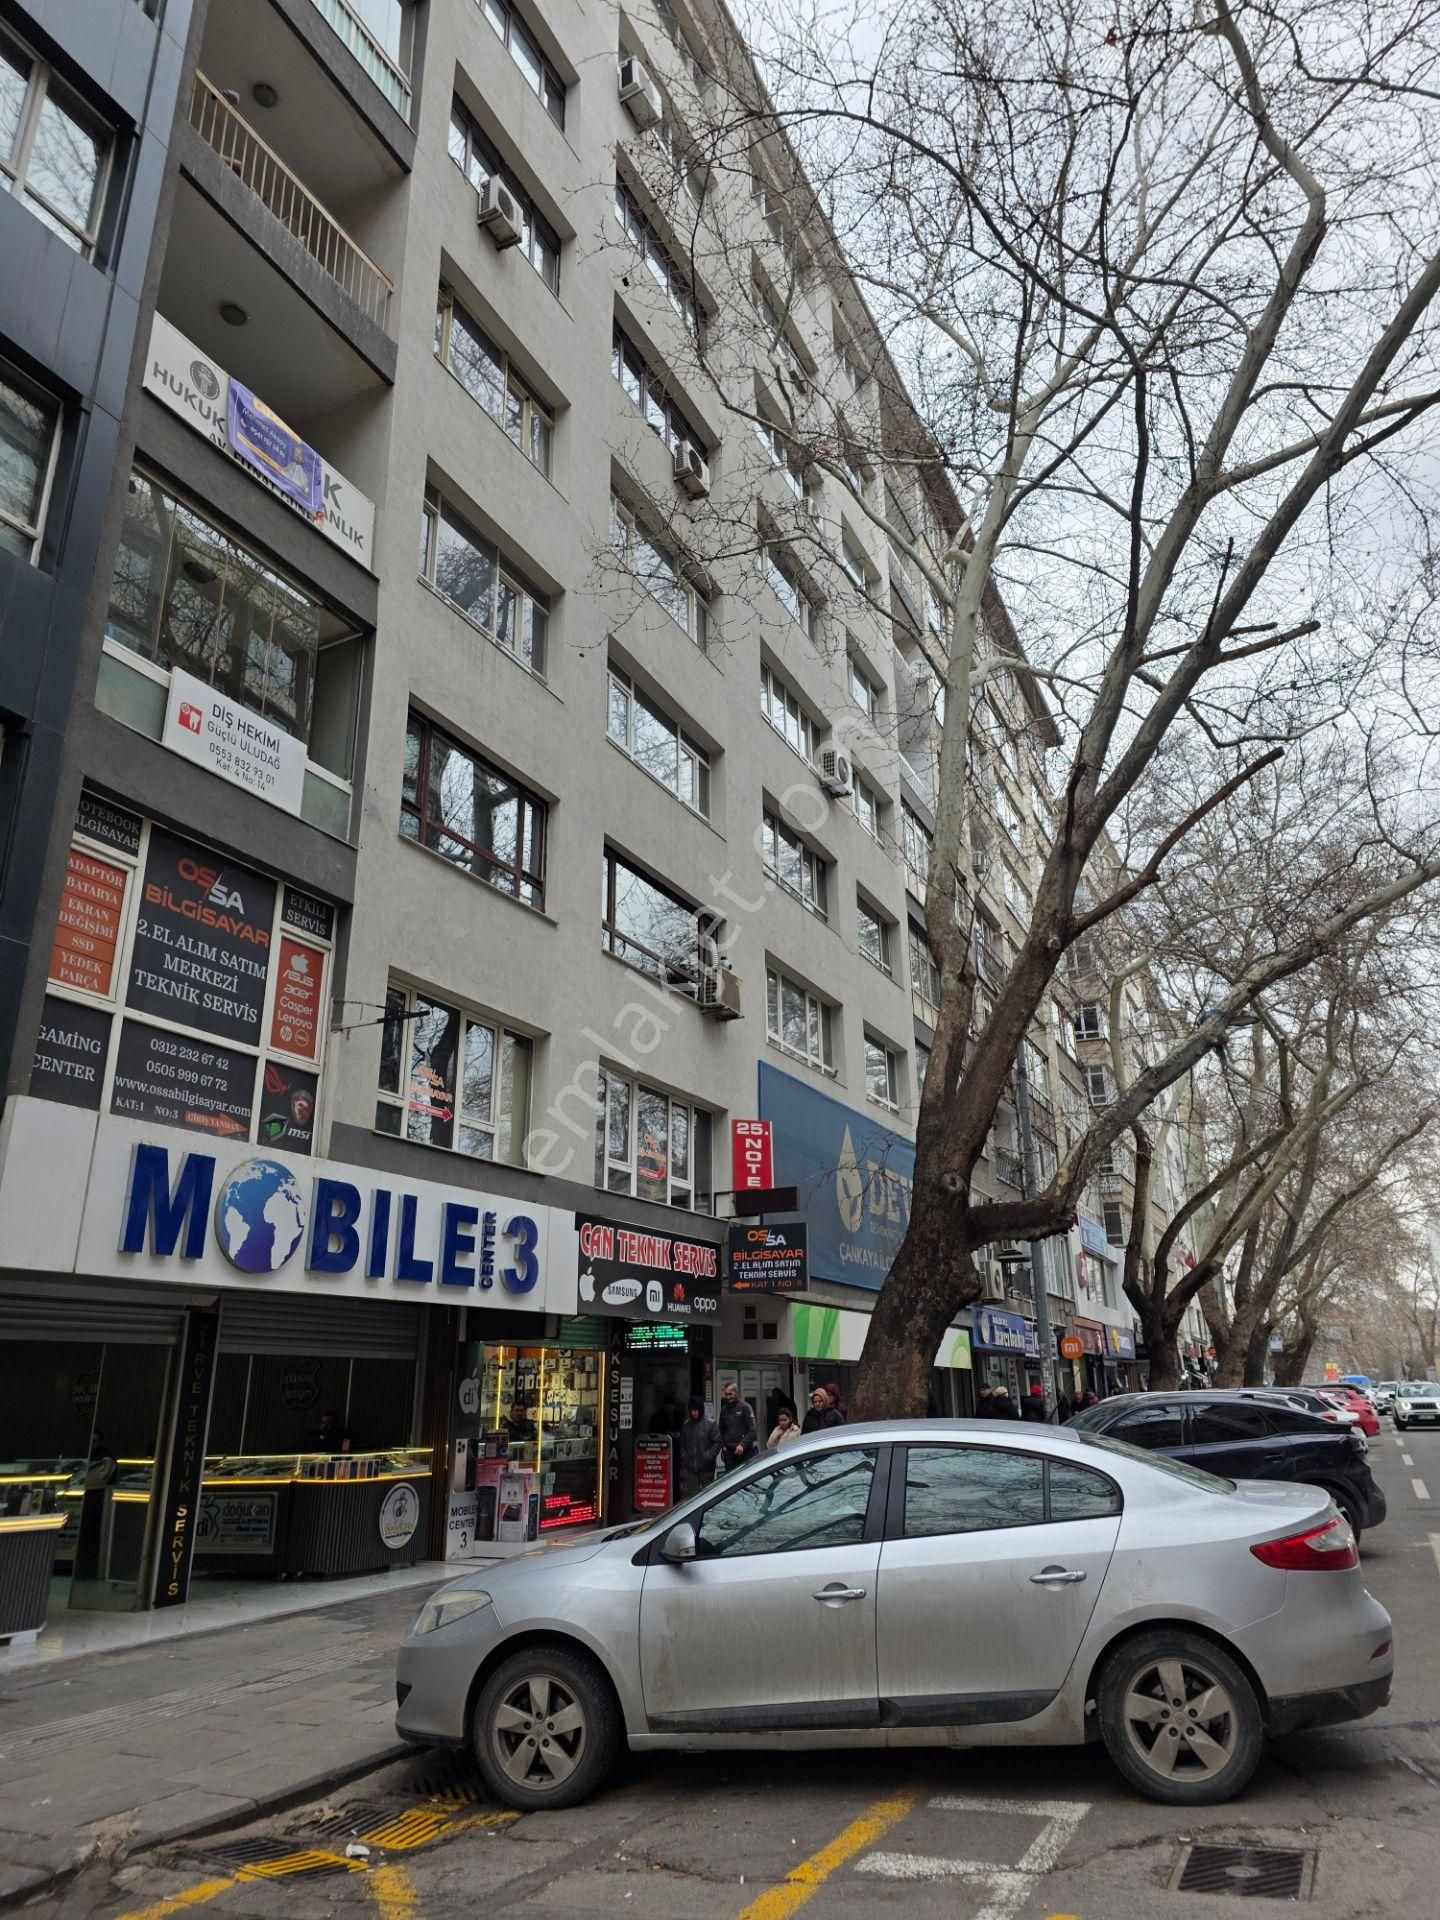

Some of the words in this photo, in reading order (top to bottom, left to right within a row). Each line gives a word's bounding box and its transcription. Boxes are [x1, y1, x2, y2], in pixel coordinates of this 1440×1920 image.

[153, 361, 227, 434] HUKUK
[212, 703, 234, 729] DİŞ
[237, 718, 281, 754] HEKİMİ
[207, 720, 237, 746] Güçlü
[240, 738, 281, 770] ULUDAĞ
[209, 742, 232, 762] 0553
[234, 756, 251, 773] 832
[253, 767, 263, 780] 93
[265, 774, 275, 785] 01
[215, 758, 232, 771] Kat:
[234, 767, 240, 776] 4
[242, 772, 255, 785] No:
[257, 780, 265, 791] 14
[74, 812, 140, 849] İLGİSAYAR
[80, 800, 141, 835] OTEBOOK
[67, 856, 124, 888] ADAPTÖR
[66, 875, 119, 905] BATARYA
[68, 897, 110, 921] EKRAN
[144, 882, 270, 949] BİLGİSAYAR
[289, 893, 326, 920] ETKİLİ
[58, 909, 115, 939] DEĞİŞİMİ
[286, 908, 327, 936] SERVİS
[71, 935, 95, 952] SSD
[136, 917, 174, 946] 2.EL
[174, 934, 218, 962] ALIM
[219, 950, 267, 981] SATIM
[61, 952, 103, 974] YEDEK
[162, 952, 239, 994] MERKEZİ
[59, 967, 100, 990] PARÇA
[283, 983, 313, 1000] acer
[134, 968, 201, 1006] TEKNİK
[202, 992, 258, 1024] SERVİS
[279, 995, 314, 1017] Casper
[277, 1009, 313, 1031] Lenovo
[150, 1038, 177, 1057] 0312
[178, 1045, 200, 1063] 232
[201, 1050, 215, 1066] 67
[215, 1055, 230, 1070] 42
[146, 1060, 176, 1079] 0505
[177, 1068, 199, 1085] 999
[200, 1072, 214, 1088] 67
[214, 1077, 229, 1092] 72
[114, 1075, 252, 1118] www.ossabilgisayar.com
[115, 1095, 145, 1112] KAT:1
[153, 1105, 179, 1119] NO:3
[287, 1126, 312, 1141] msi
[736, 1122, 769, 1136] 25.
[745, 1138, 762, 1187] NOTE
[867, 1160, 914, 1226] DEV
[477, 1210, 498, 1290] CENTER
[500, 1214, 539, 1294] 3
[747, 1228, 787, 1248] OSSA
[617, 1229, 672, 1270] TEKNİK
[673, 1241, 717, 1279] SERVİS
[733, 1248, 804, 1261] BİLGİSAYAR
[752, 1259, 774, 1270] ALIM
[774, 1258, 801, 1269] SATIM
[839, 1242, 879, 1269] ÇANKAYA
[739, 1268, 767, 1280] TEKNİK
[768, 1267, 797, 1279] SERVİS
[751, 1280, 768, 1289] KAT
[607, 1285, 638, 1299] SAMSUNG
[667, 1302, 691, 1314] HUAWEI
[693, 1297, 717, 1313] oppo
[609, 1333, 621, 1480] AKSESUAR
[449, 1519, 475, 1530] CENTER
[460, 1532, 468, 1549] 3
